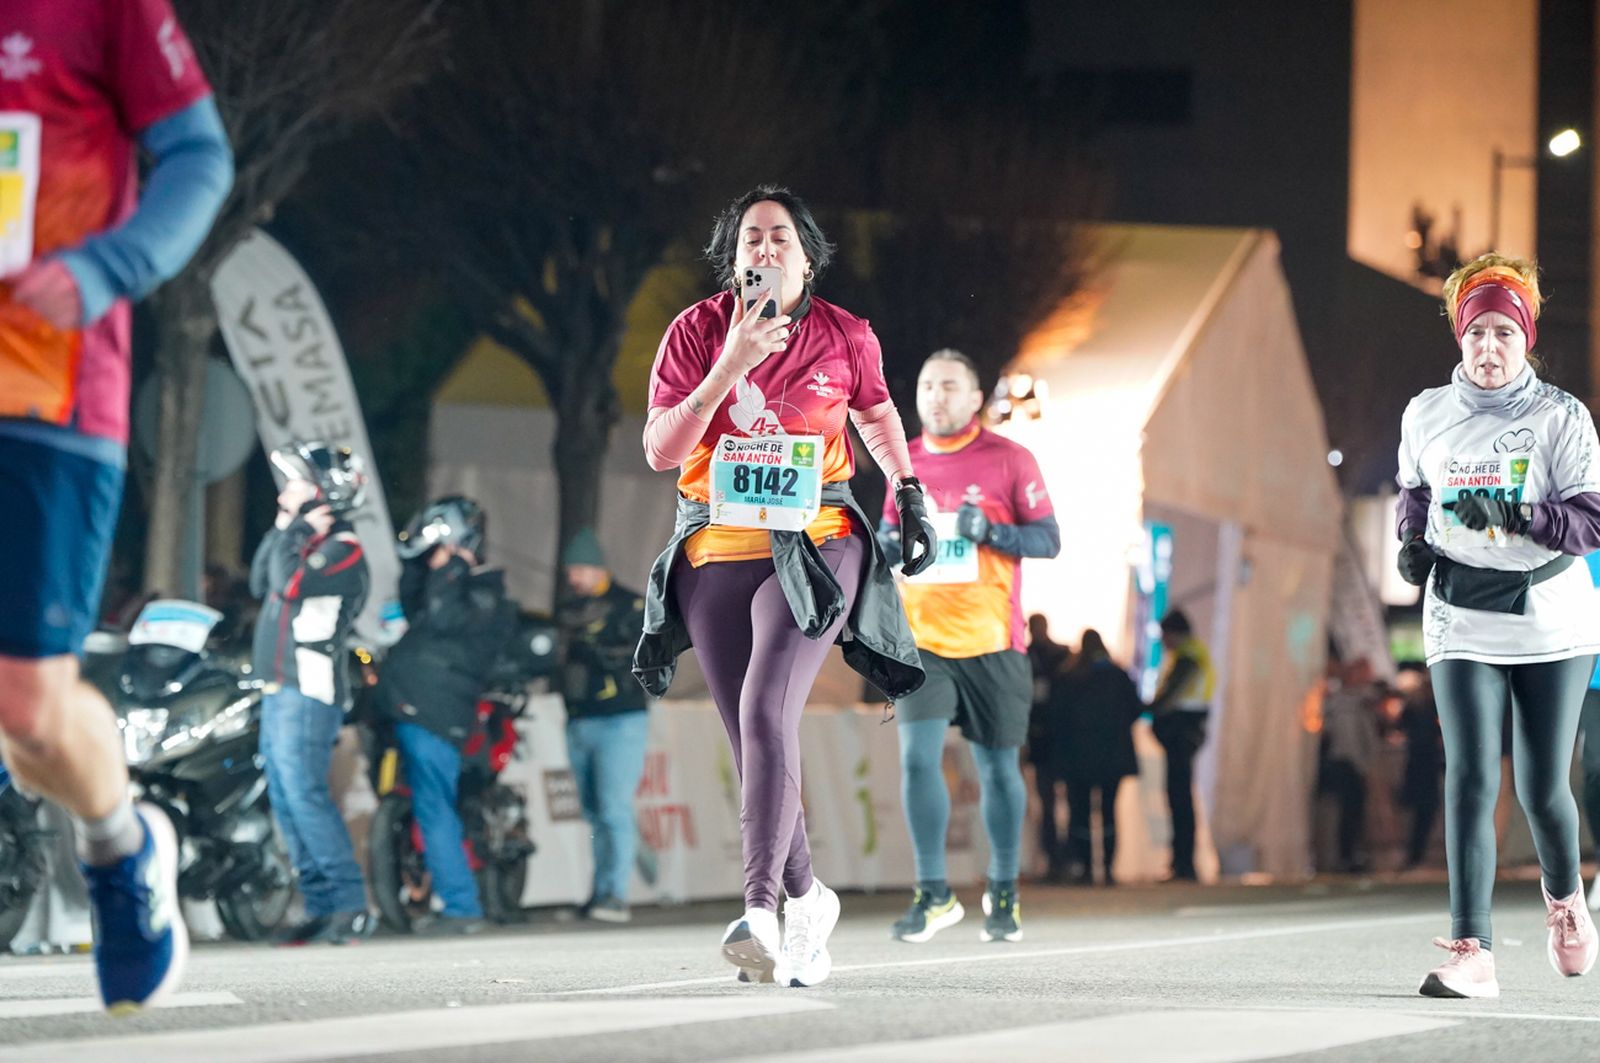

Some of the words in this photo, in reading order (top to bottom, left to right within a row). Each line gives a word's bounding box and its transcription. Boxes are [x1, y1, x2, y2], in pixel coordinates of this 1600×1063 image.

[737, 442, 769, 452] NOCHE
[770, 443, 783, 453] DE
[723, 452, 745, 462] SAN
[745, 453, 783, 465] ANTÓN
[1458, 464, 1488, 474] NOHE
[1489, 464, 1501, 473] DE
[733, 464, 799, 496] 8142
[1447, 476, 1466, 486] SAN
[1468, 474, 1501, 486] ANTÓN
[938, 540, 964, 558] 76
